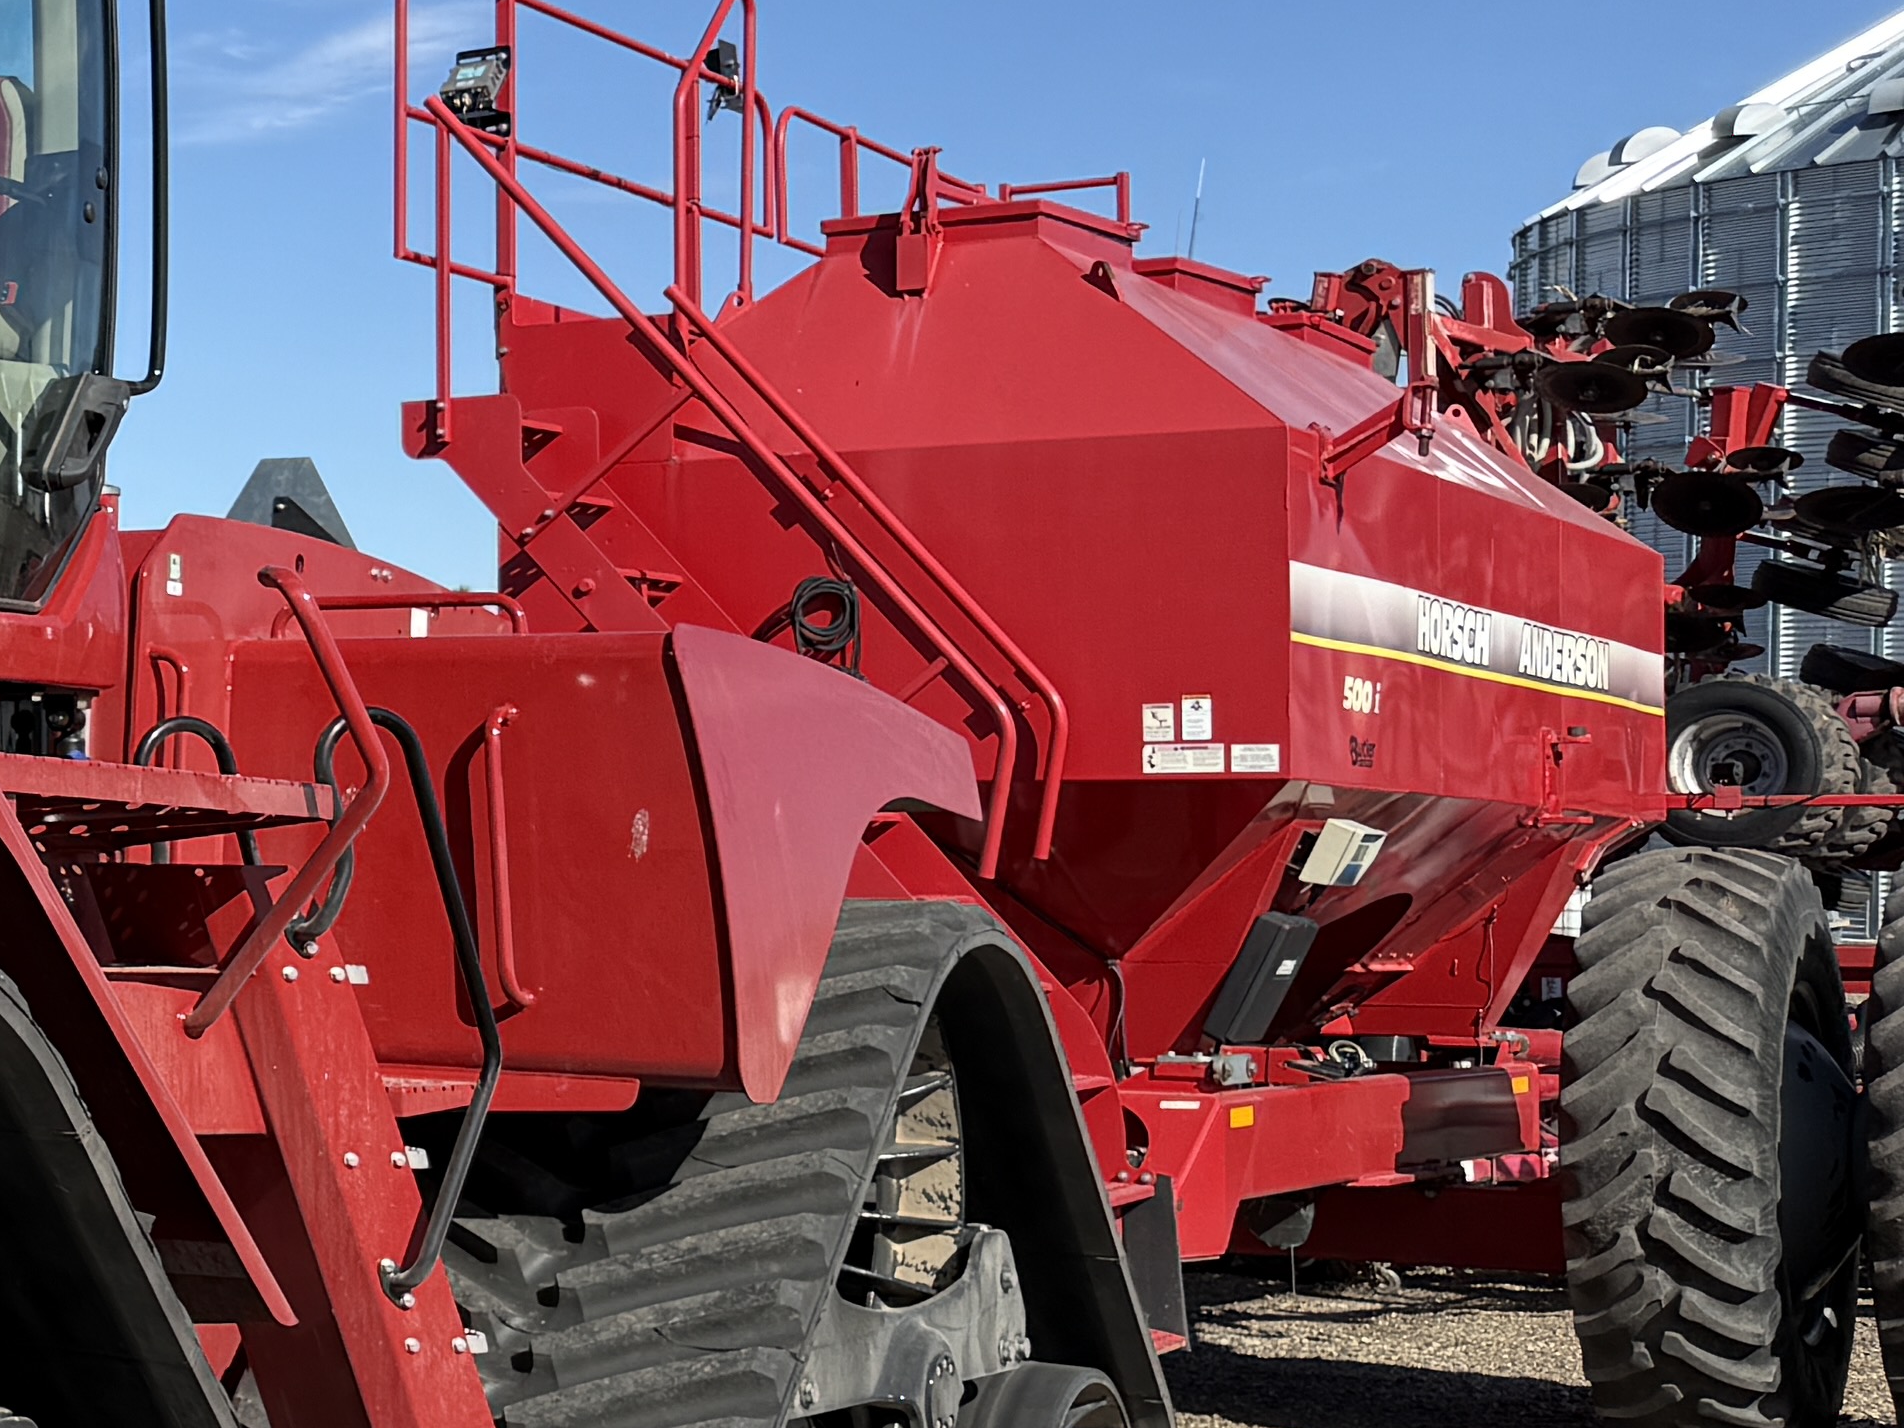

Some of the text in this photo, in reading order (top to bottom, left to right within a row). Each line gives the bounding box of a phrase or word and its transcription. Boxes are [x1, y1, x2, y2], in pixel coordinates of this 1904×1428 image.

[1416, 594, 1610, 691] HORSCH ANDERSON
[1342, 675, 1373, 714] 500
